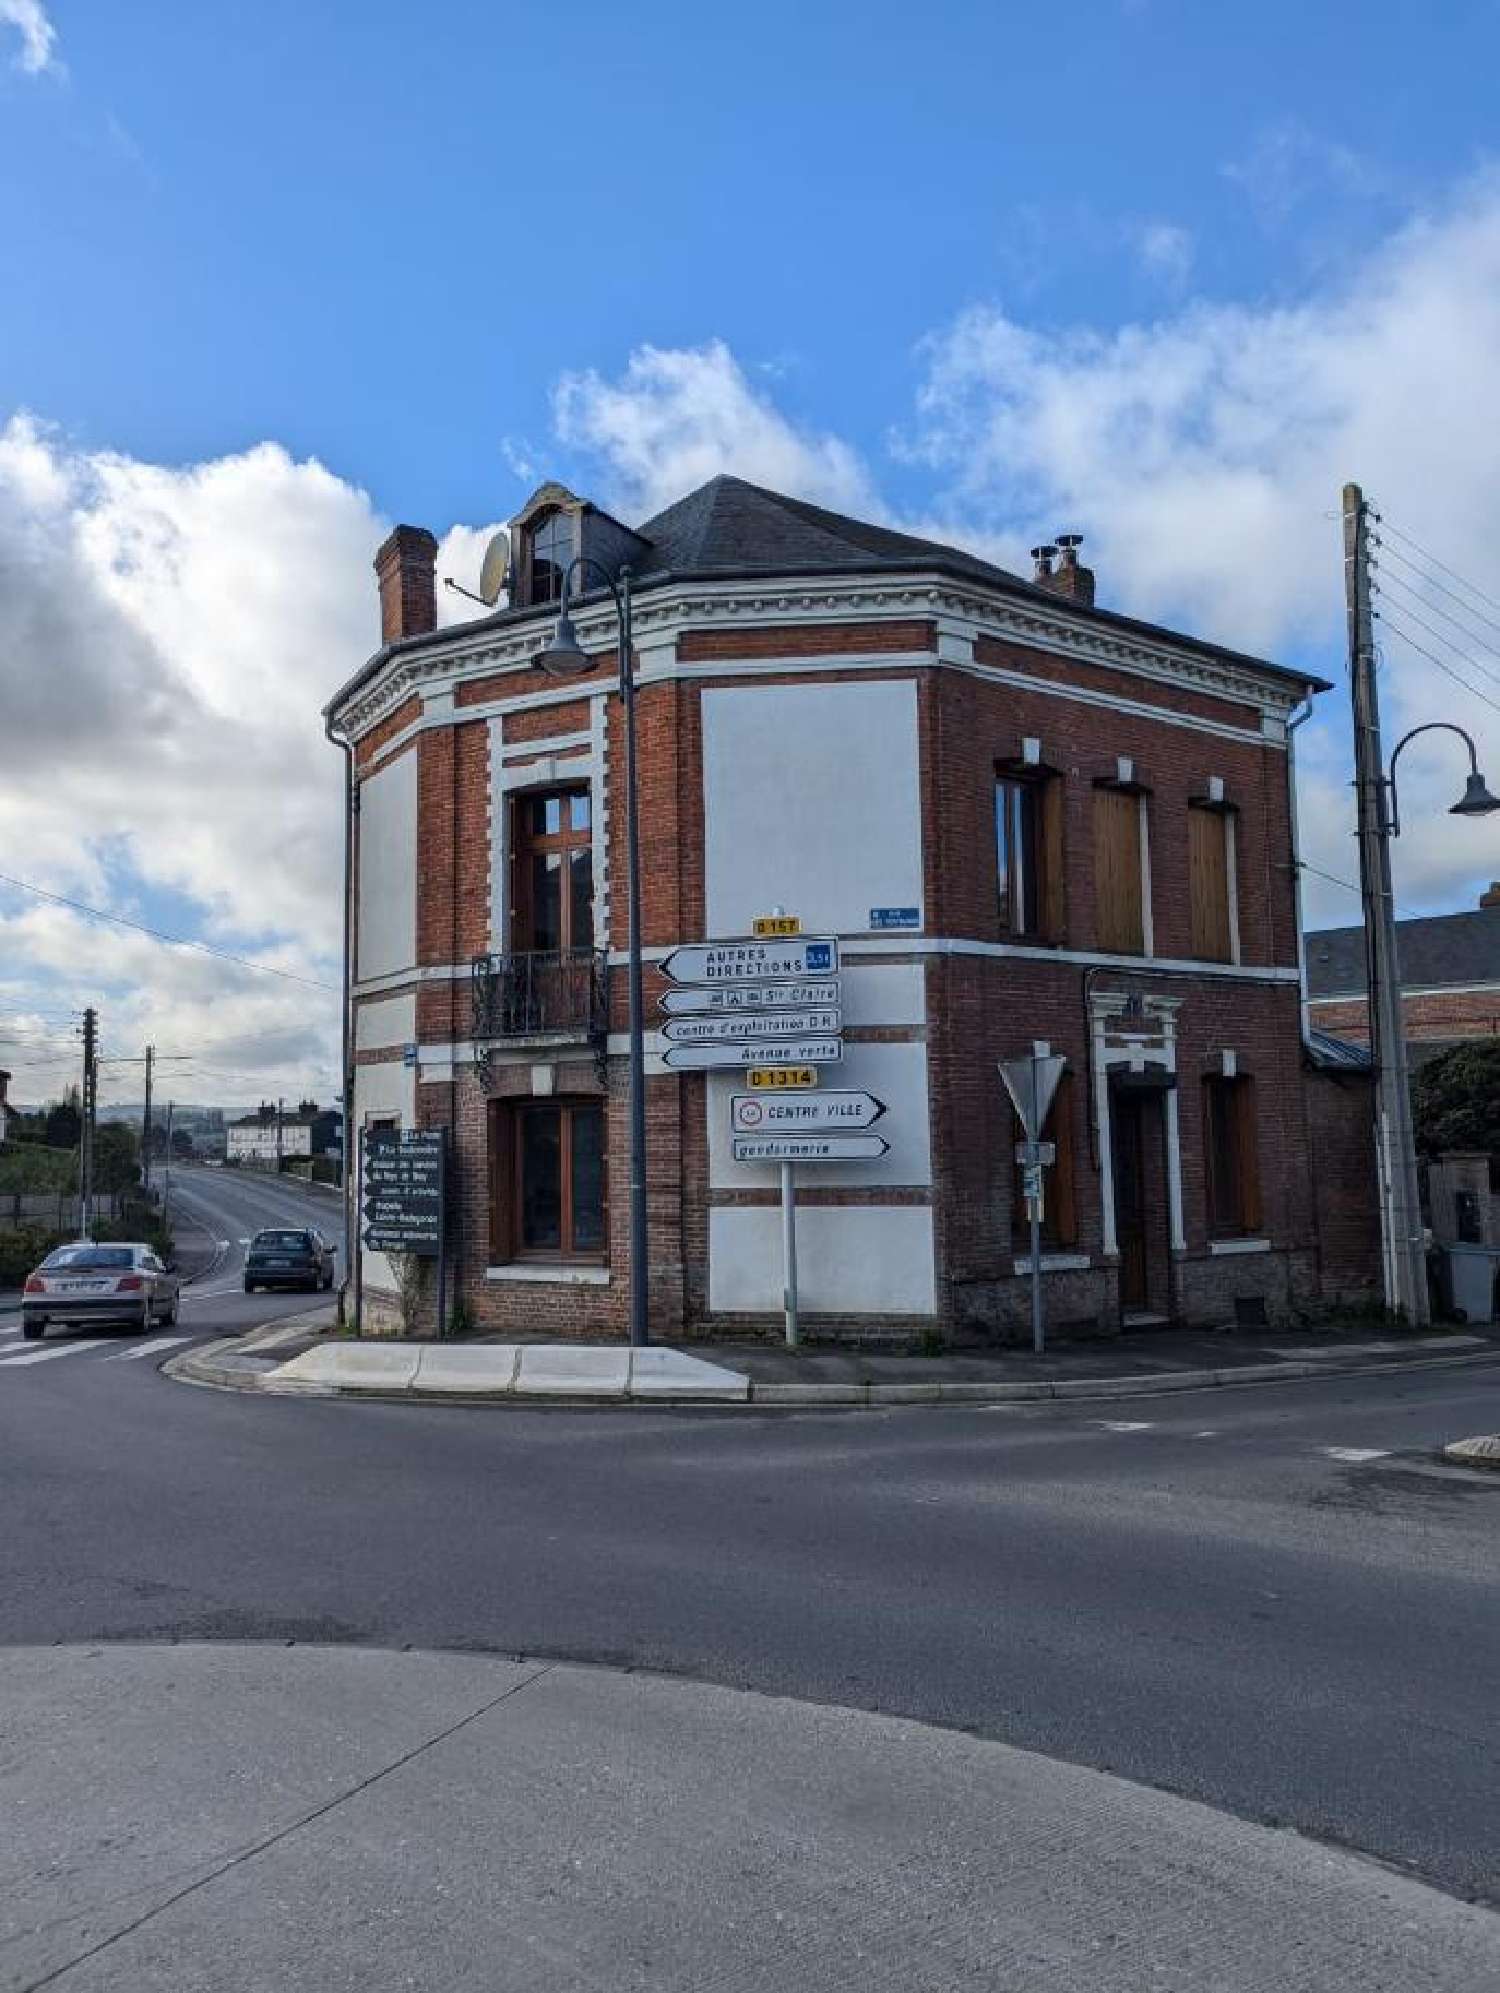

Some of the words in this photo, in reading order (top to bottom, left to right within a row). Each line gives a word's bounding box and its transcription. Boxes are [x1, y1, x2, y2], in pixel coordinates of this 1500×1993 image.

[706, 949, 767, 964] AUTRES
[706, 959, 802, 977] DIRECTIONS
[768, 1105, 818, 1119] CENTRE
[827, 1104, 863, 1116] VILLE
[739, 1143, 830, 1158] gendarmerie
